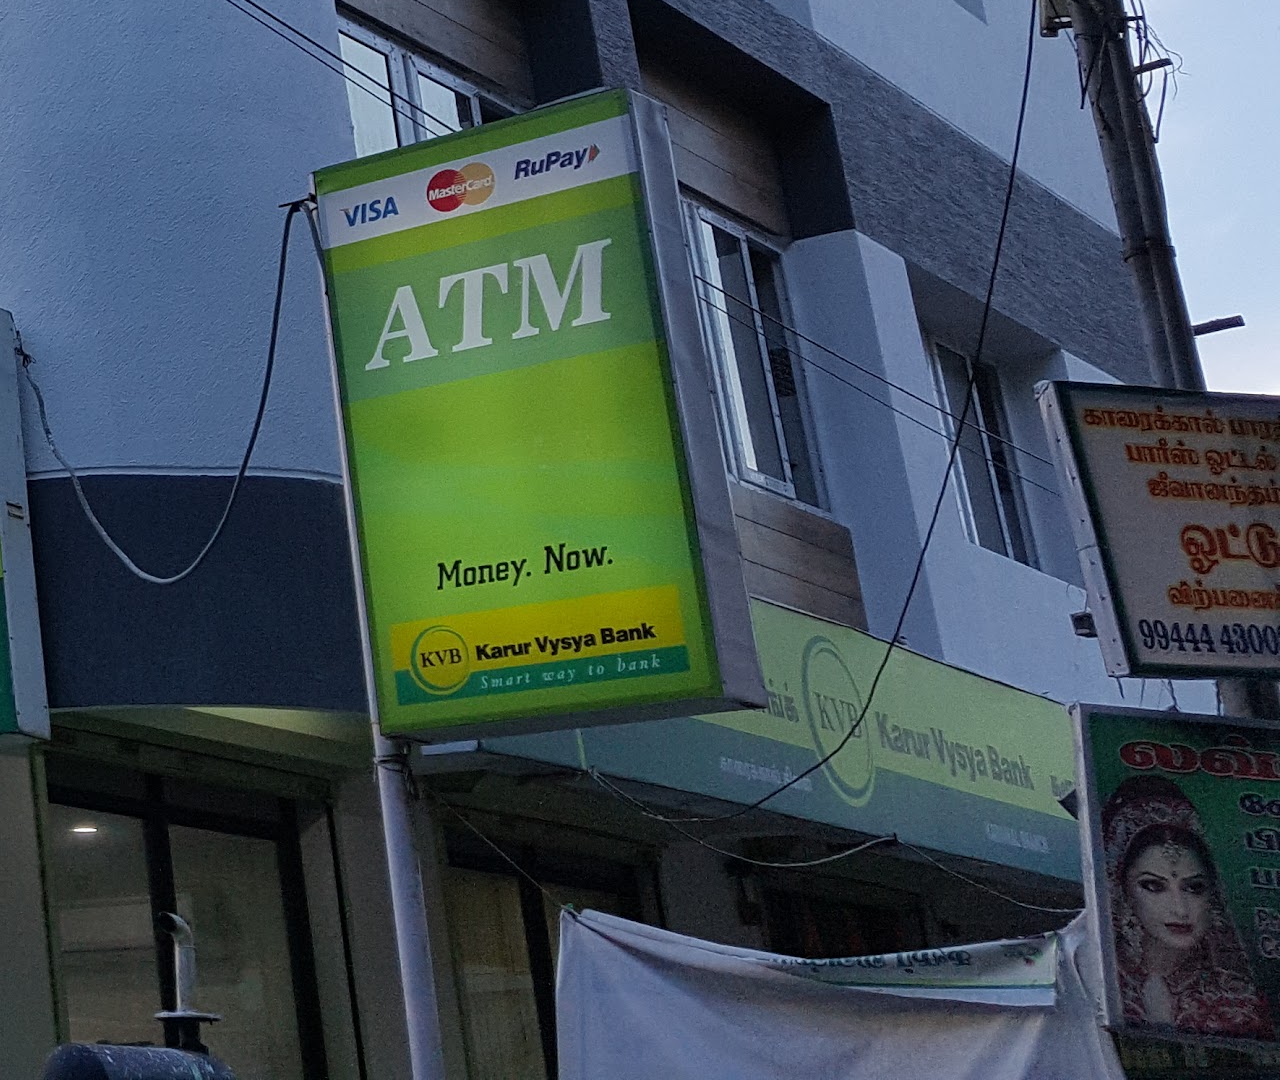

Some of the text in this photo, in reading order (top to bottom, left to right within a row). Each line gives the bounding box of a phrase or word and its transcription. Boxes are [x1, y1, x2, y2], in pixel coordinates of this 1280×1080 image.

[515, 147, 588, 180] RuPay
[428, 175, 495, 201] MasterCard
[341, 195, 399, 227] VISA
[365, 238, 612, 371] ATM
[437, 543, 613, 590] Money. Now.
[475, 622, 657, 660] Karur Vysya Bank
[1139, 619, 1280, 655] 99444 4300
[420, 645, 462, 667] KVB
[480, 654, 662, 690] Smart way to bank
[814, 692, 863, 738] KVB
[876, 711, 931, 760] Karur
[930, 727, 987, 782] Vysya
[987, 745, 1036, 790] Bank
